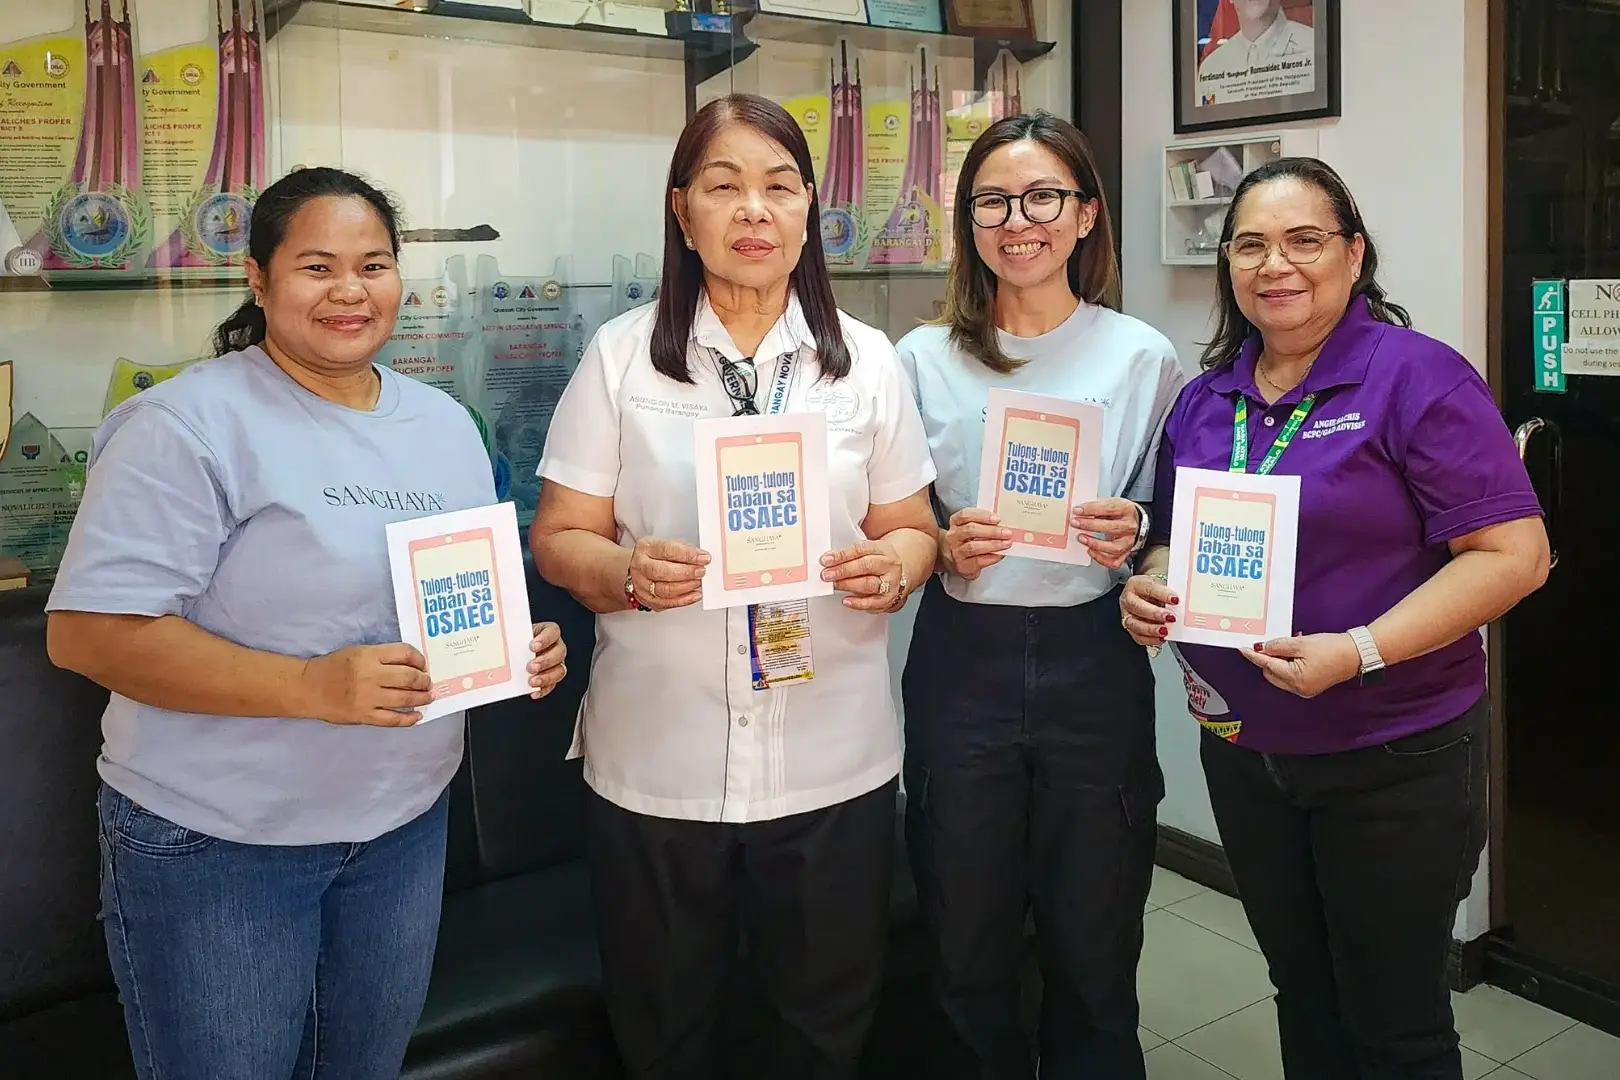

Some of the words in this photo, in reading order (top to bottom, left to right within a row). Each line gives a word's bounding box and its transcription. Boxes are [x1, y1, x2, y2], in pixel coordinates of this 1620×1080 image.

[1250, 64, 1280, 75] Romualdez
[1281, 60, 1303, 70] Marcos
[1304, 58, 1312, 67] Jr.
[1571, 310, 1601, 319] CELL
[393, 357, 437, 365] BARANGAY
[1542, 316, 1558, 387] PUSH
[1605, 346, 1618, 355] the
[427, 365, 455, 373] PROPER
[1583, 360, 1608, 369] during
[682, 401, 708, 412] VISAYA
[1313, 419, 1337, 429] ANGIE
[1008, 441, 1070, 467] Tulong-tulong
[1006, 457, 1046, 476] laban
[1050, 465, 1068, 480] sa
[726, 470, 795, 492] Tulong-tulong
[1003, 472, 1066, 499] OSAEC
[323, 485, 443, 511] SANGHAYA
[728, 491, 772, 509] laban
[777, 489, 796, 503] sa
[728, 503, 798, 532] OSAEC
[1199, 522, 1266, 544] Tulong-tulong
[1198, 538, 1241, 557] laban
[1246, 546, 1264, 559] sa
[1196, 553, 1263, 580] OSAEC
[421, 569, 490, 597] Tulong-tulong
[424, 592, 467, 614] laban
[472, 587, 492, 602] sa
[426, 602, 495, 638] OSAEC
